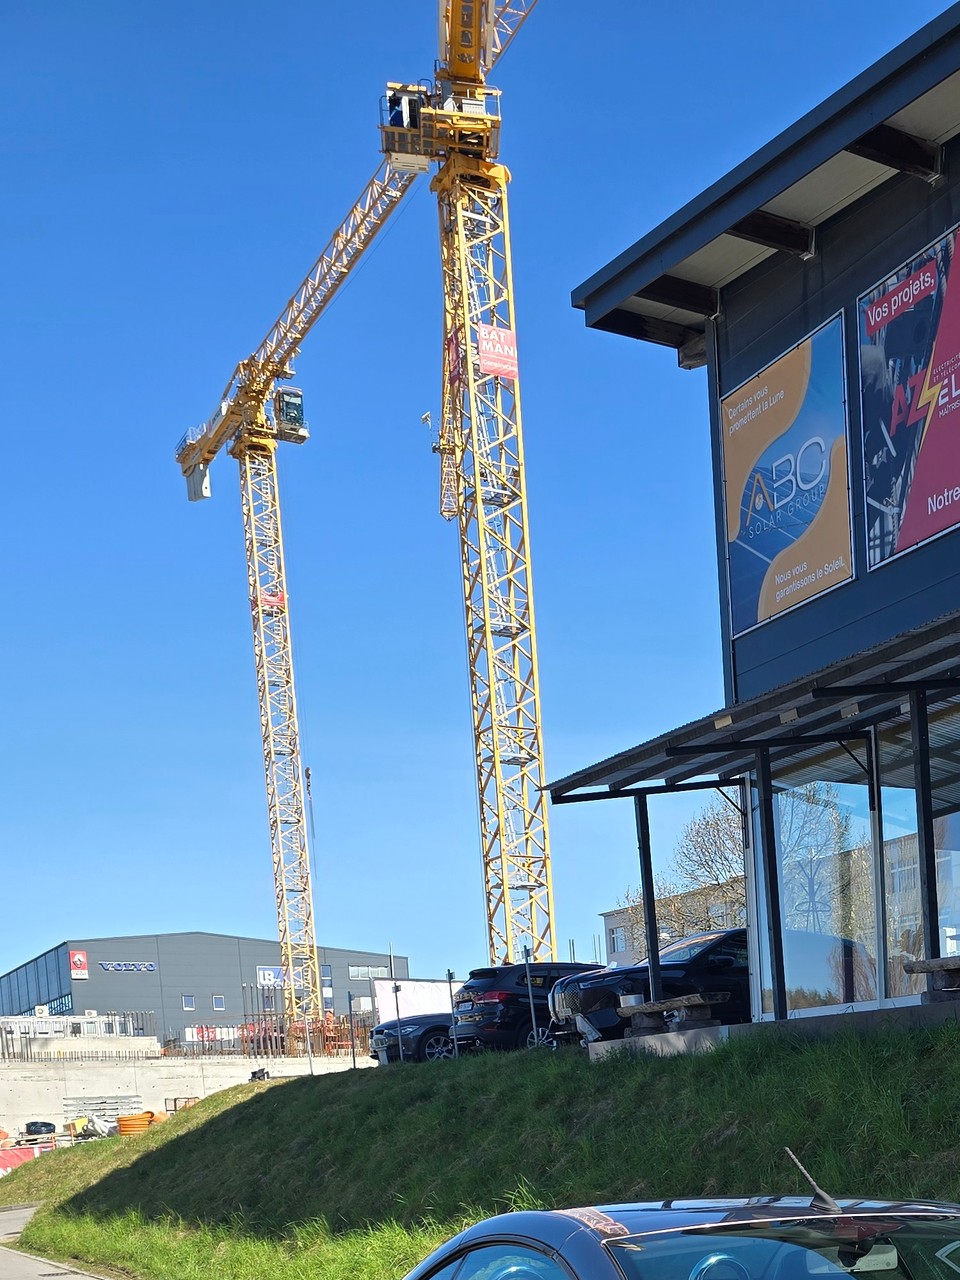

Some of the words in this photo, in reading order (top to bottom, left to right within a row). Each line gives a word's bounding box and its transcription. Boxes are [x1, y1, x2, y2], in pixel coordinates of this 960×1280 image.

[868, 303, 889, 326] Vos
[891, 272, 935, 316] projets,
[481, 327, 506, 342] BAT
[728, 397, 753, 420] Certains
[753, 385, 769, 401] vous
[729, 404, 762, 437] promettent
[762, 401, 769, 411] la
[769, 390, 785, 407] Lune
[746, 436, 826, 526] ABC
[749, 510, 781, 539] SOLAR
[787, 485, 825, 516] GROUP
[927, 486, 960, 515] Notre
[775, 569, 792, 585] Nous
[792, 561, 808, 576] vous
[775, 573, 816, 602] garantissons
[816, 568, 824, 579] le
[99, 962, 157, 972] VOLVO
